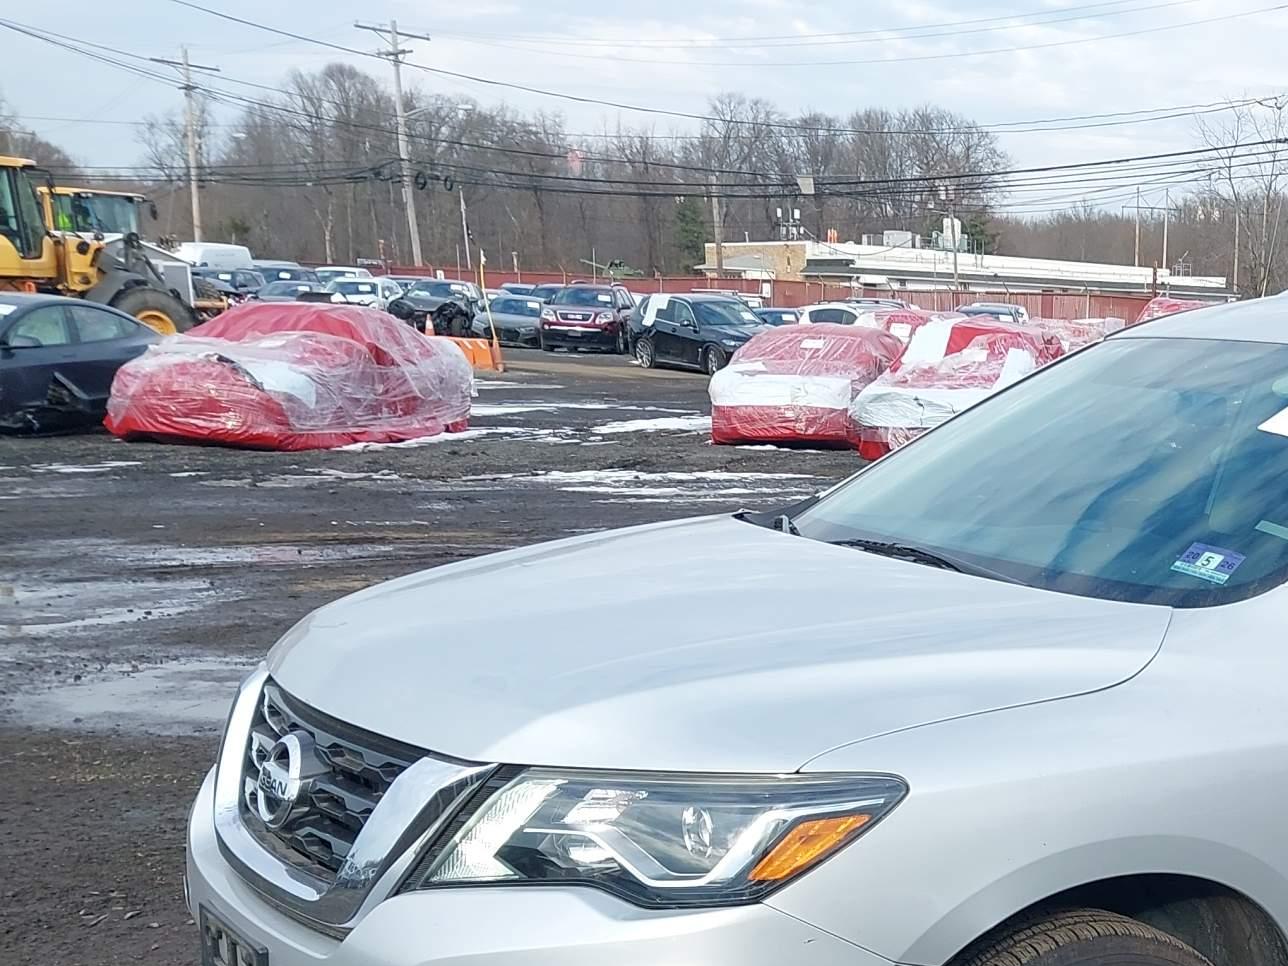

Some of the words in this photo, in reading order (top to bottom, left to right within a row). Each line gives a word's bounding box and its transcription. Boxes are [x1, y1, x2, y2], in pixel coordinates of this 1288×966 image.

[1186, 551, 1200, 560] 20
[1201, 556, 1215, 567] 5
[1220, 560, 1236, 570] 26
